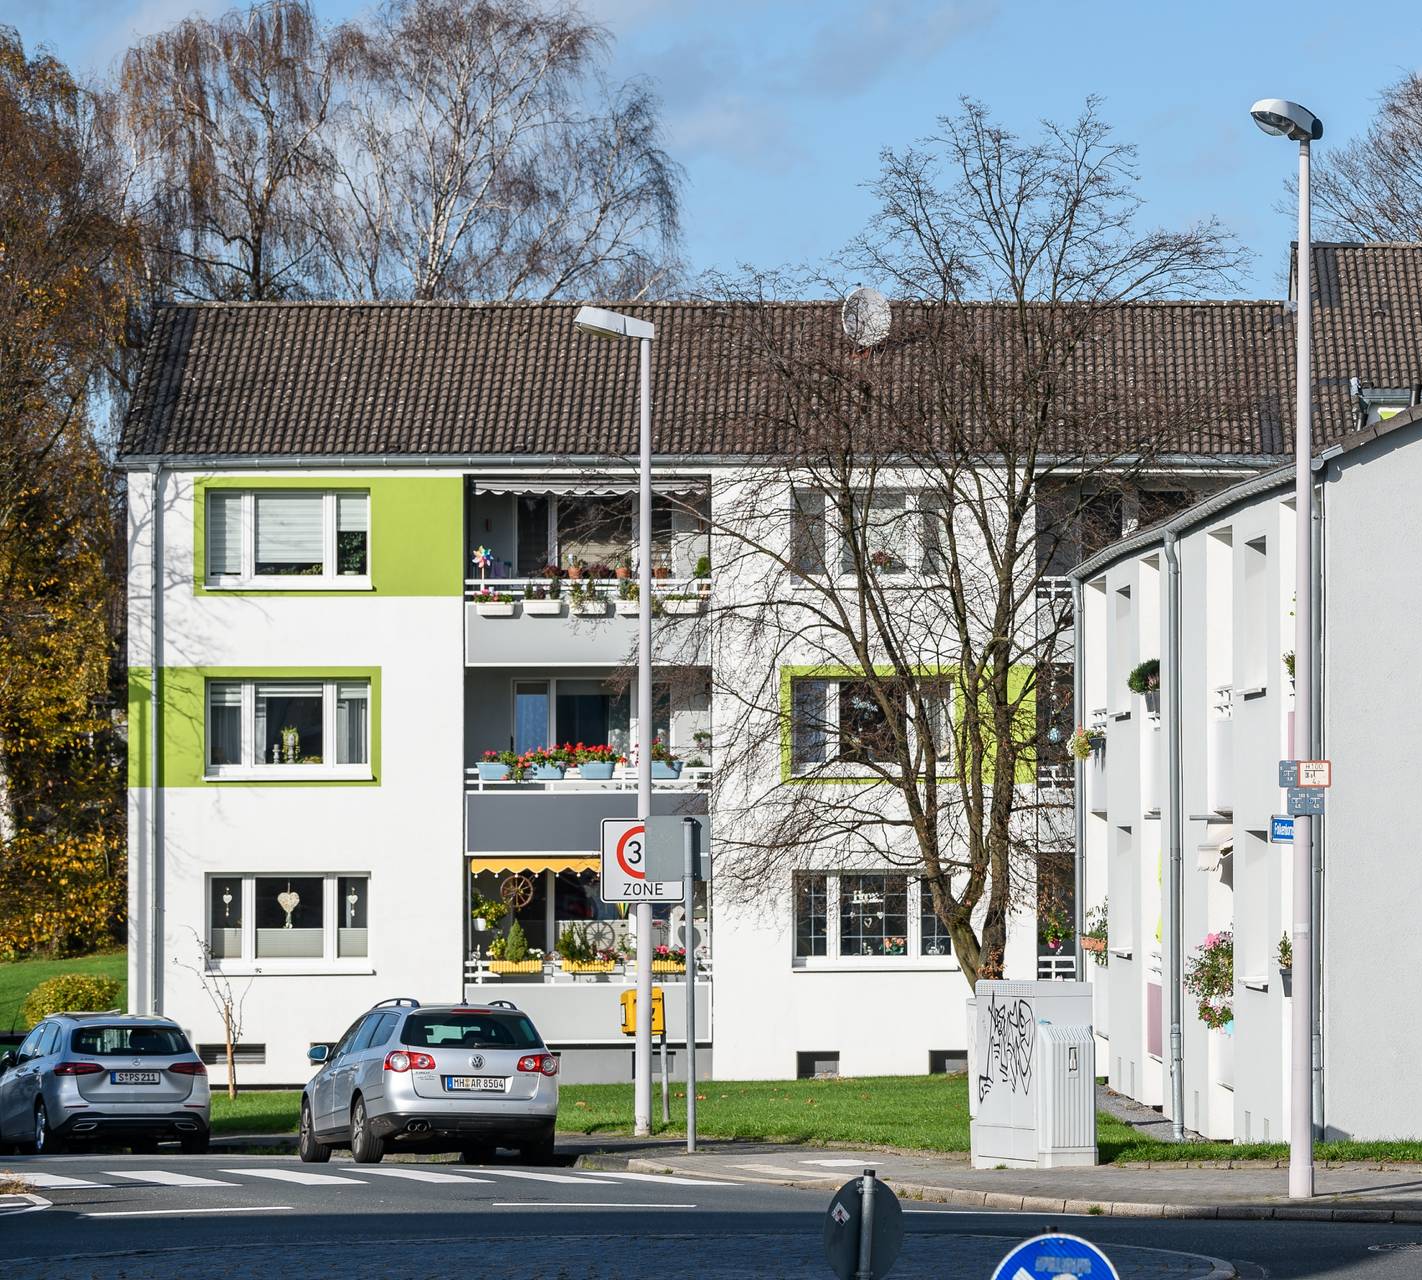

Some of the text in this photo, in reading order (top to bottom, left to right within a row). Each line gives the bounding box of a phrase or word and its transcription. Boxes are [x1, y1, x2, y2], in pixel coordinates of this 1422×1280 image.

[623, 882, 664, 896] ZONE
[453, 1078, 504, 1088] MH AR 8504
